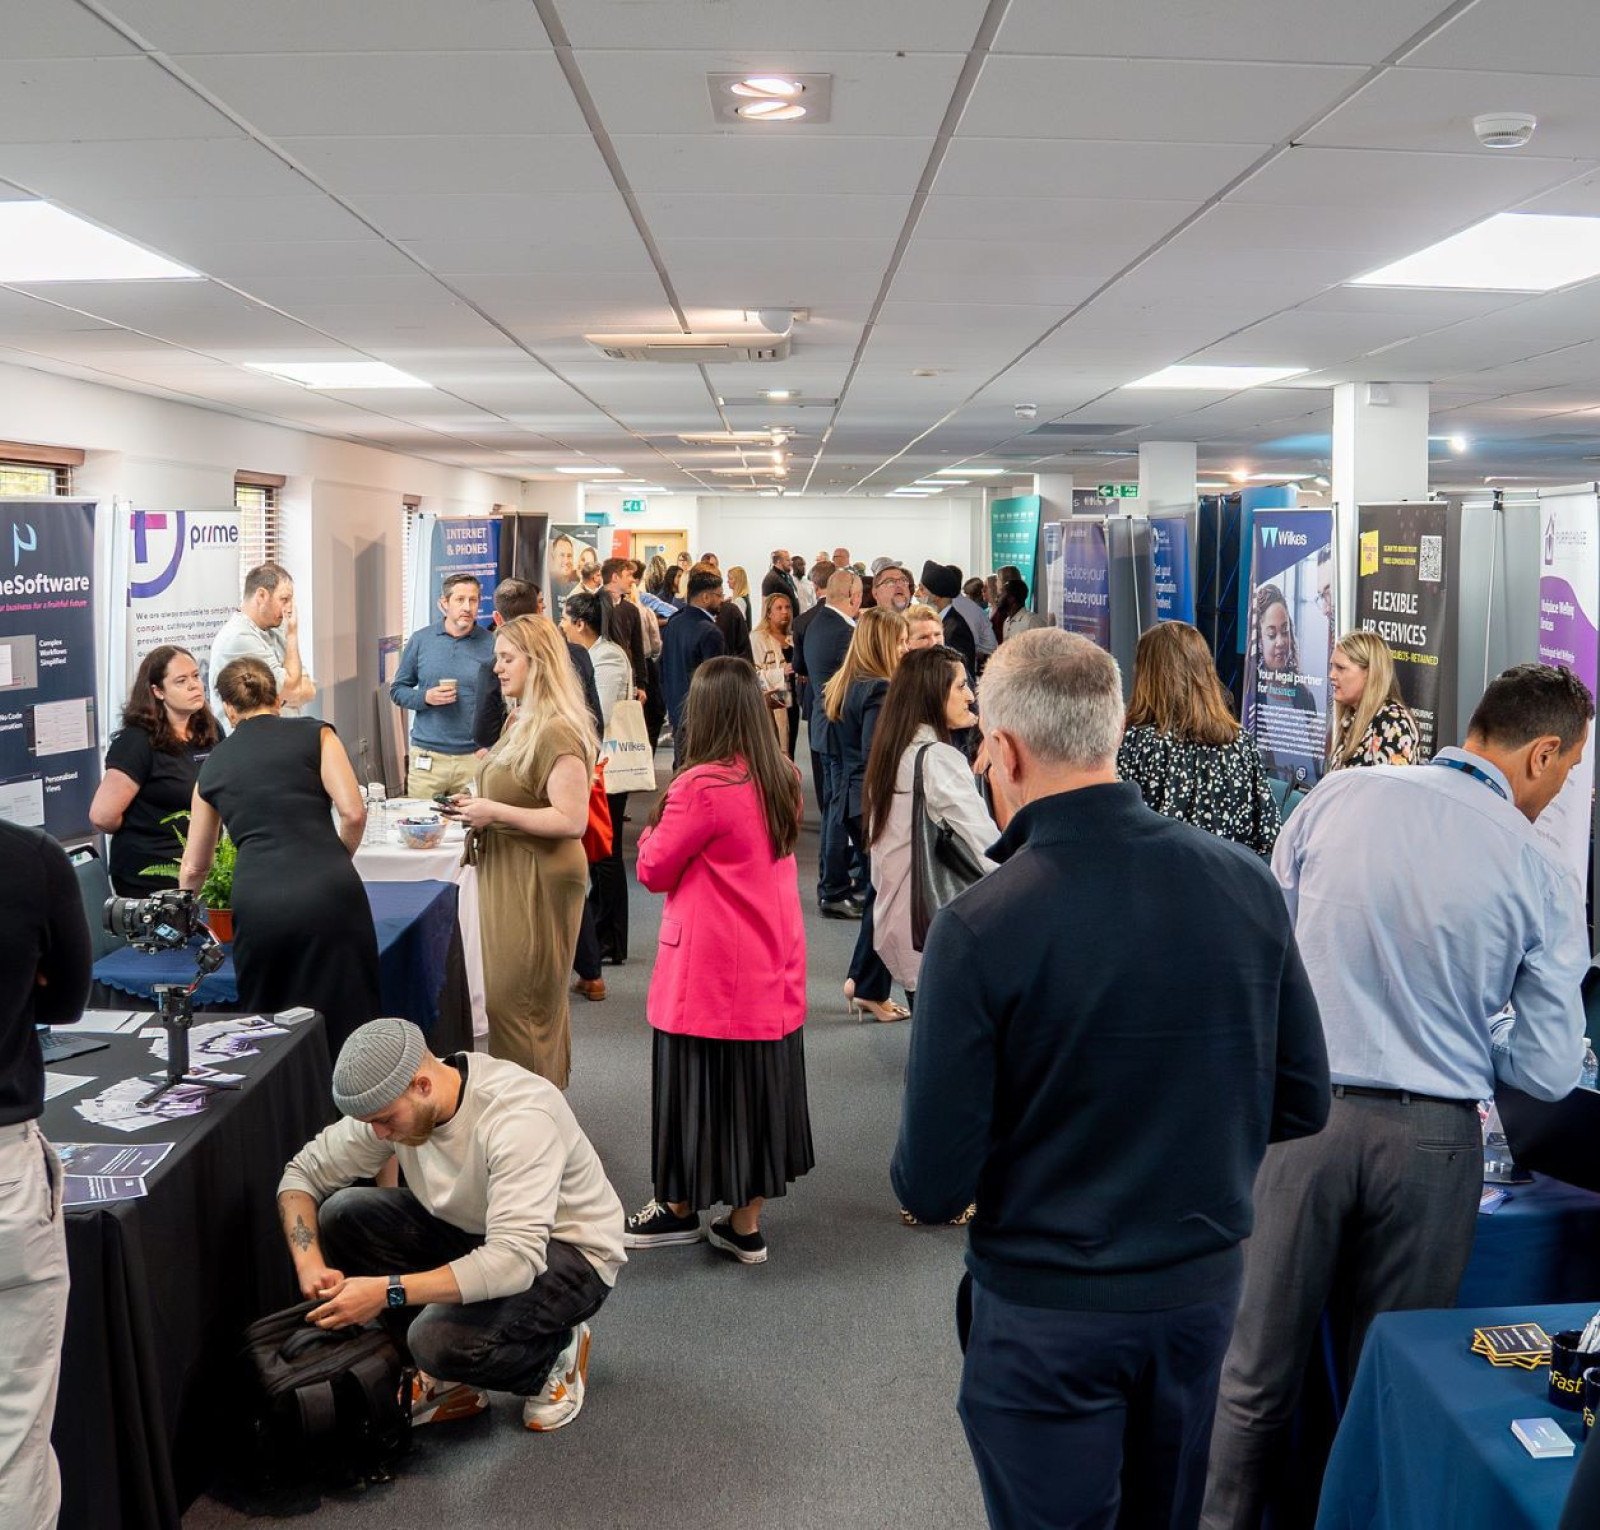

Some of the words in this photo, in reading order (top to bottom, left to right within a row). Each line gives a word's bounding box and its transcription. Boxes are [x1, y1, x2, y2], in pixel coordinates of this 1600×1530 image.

[190, 525, 238, 550] prime
[446, 527, 487, 539] INTERNET
[1278, 530, 1308, 546] Wilkes
[446, 543, 454, 556] &
[455, 542, 488, 555] PHONES
[1088, 593, 1108, 608] your
[1372, 590, 1418, 614] FLEXIBLE
[136, 612, 148, 620] We
[1362, 618, 1376, 633] HR
[1378, 620, 1427, 646] SERVICES
[39, 640, 62, 648] Complex
[1258, 669, 1274, 679] Your
[1275, 670, 1293, 683] legal
[1294, 674, 1323, 686] partner
[1257, 682, 1268, 693] for
[618, 740, 646, 752] Wilkes
[1552, 1370, 1584, 1393] Fast
